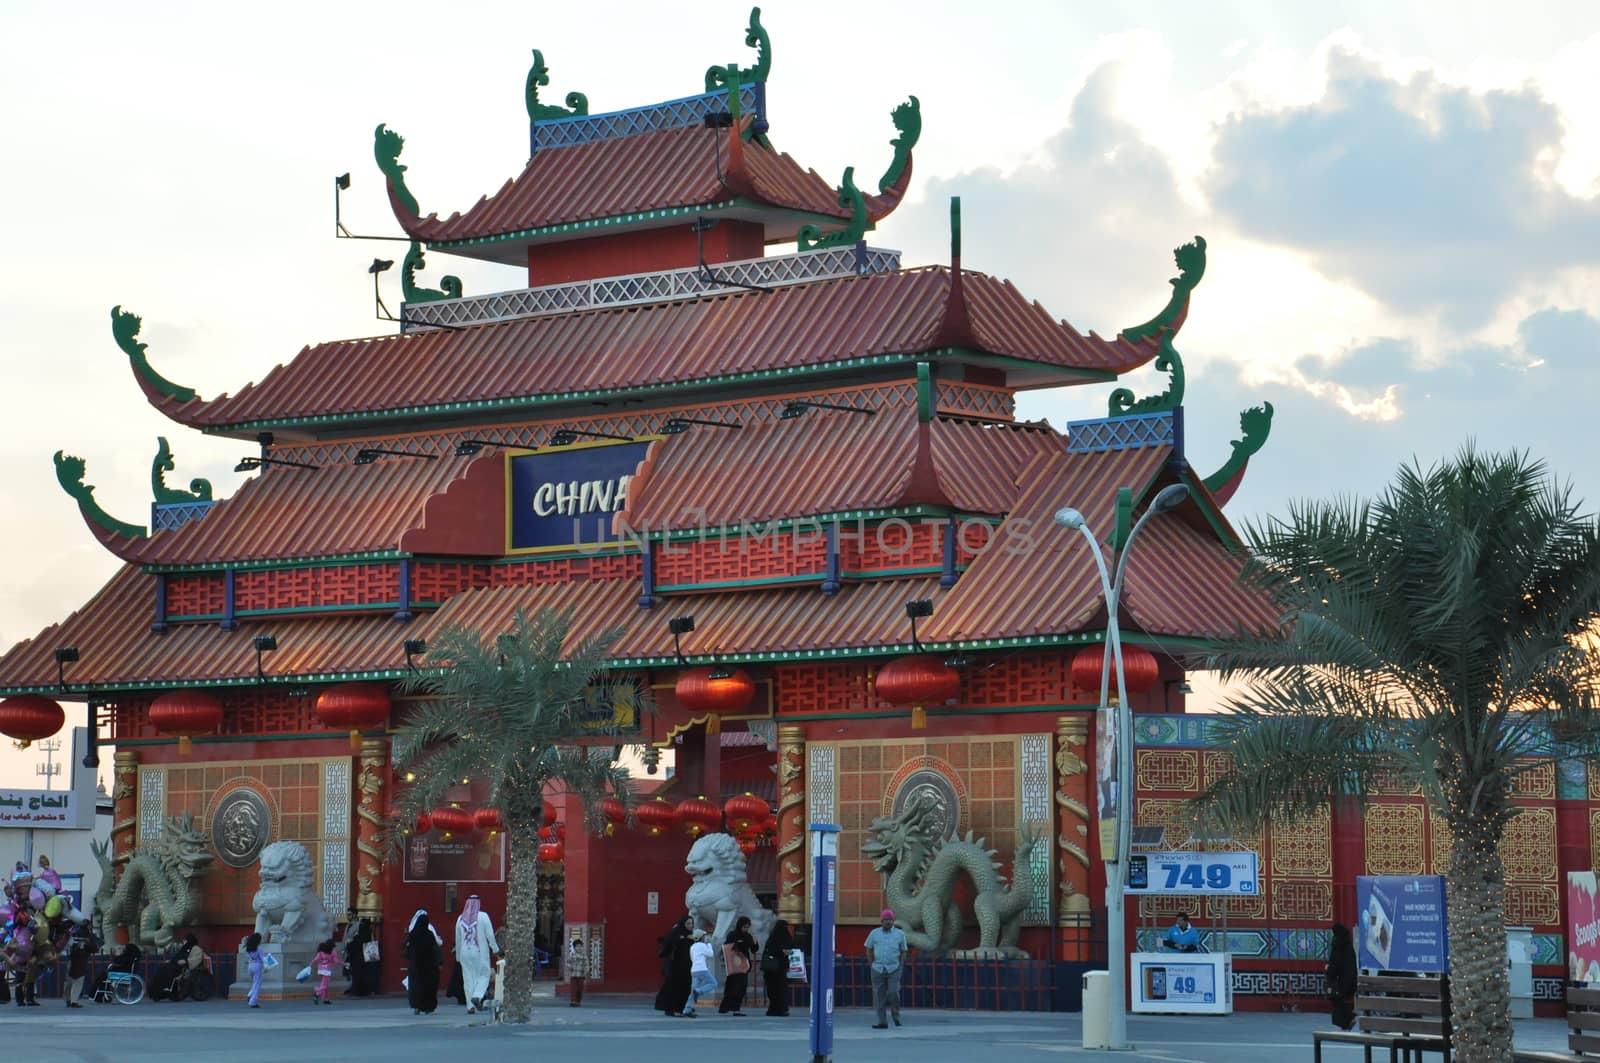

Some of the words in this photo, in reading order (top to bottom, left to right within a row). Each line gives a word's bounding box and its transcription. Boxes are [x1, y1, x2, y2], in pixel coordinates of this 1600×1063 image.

[533, 475, 630, 517] CHINA
[28, 793, 68, 810] الحاج
[1161, 863, 1231, 888] 749
[1174, 976, 1195, 994] 49
